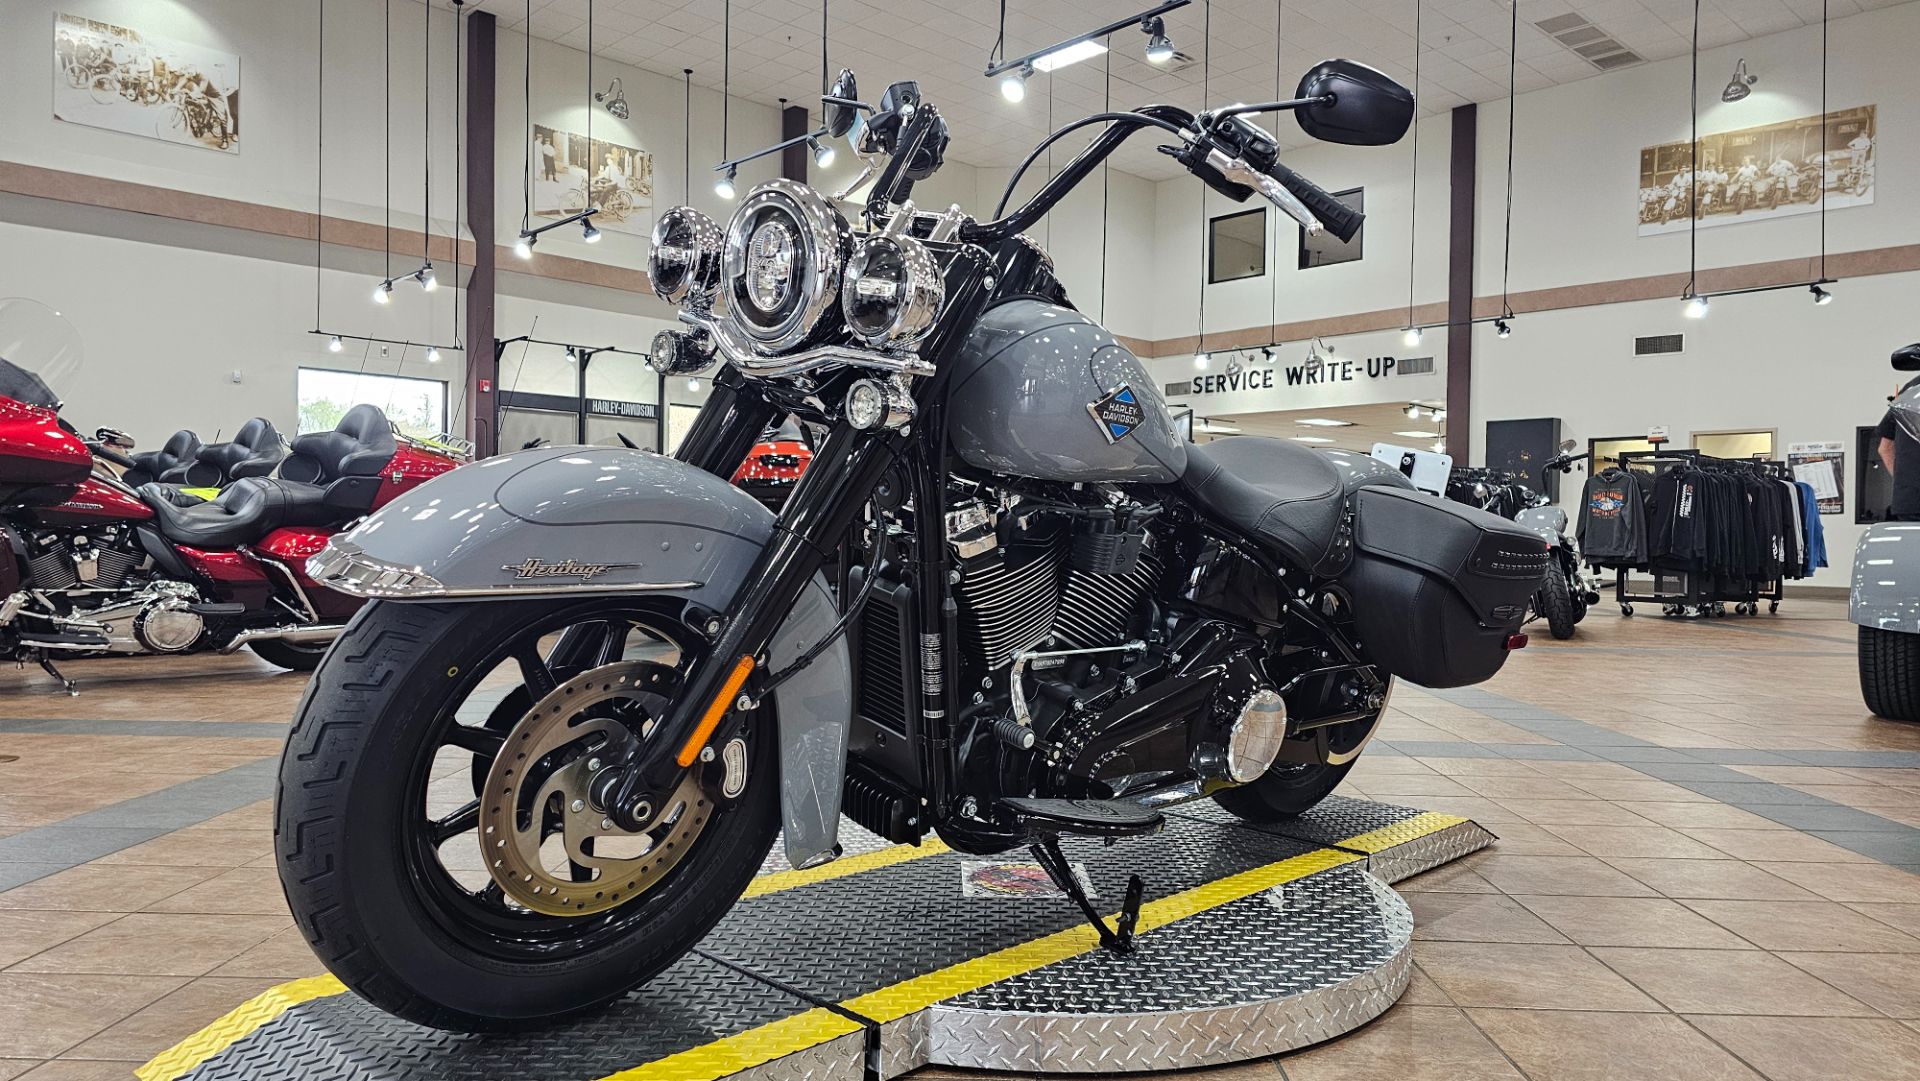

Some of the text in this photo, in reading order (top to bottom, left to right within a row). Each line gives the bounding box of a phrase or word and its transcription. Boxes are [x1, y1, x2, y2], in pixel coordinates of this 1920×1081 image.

[1192, 356, 1395, 394] SERVICE WRITE-UP
[592, 400, 656, 418] HARLEY-DAVIDSON
[1102, 410, 1140, 425] DAVIDSON
[515, 558, 609, 580] Heritage
